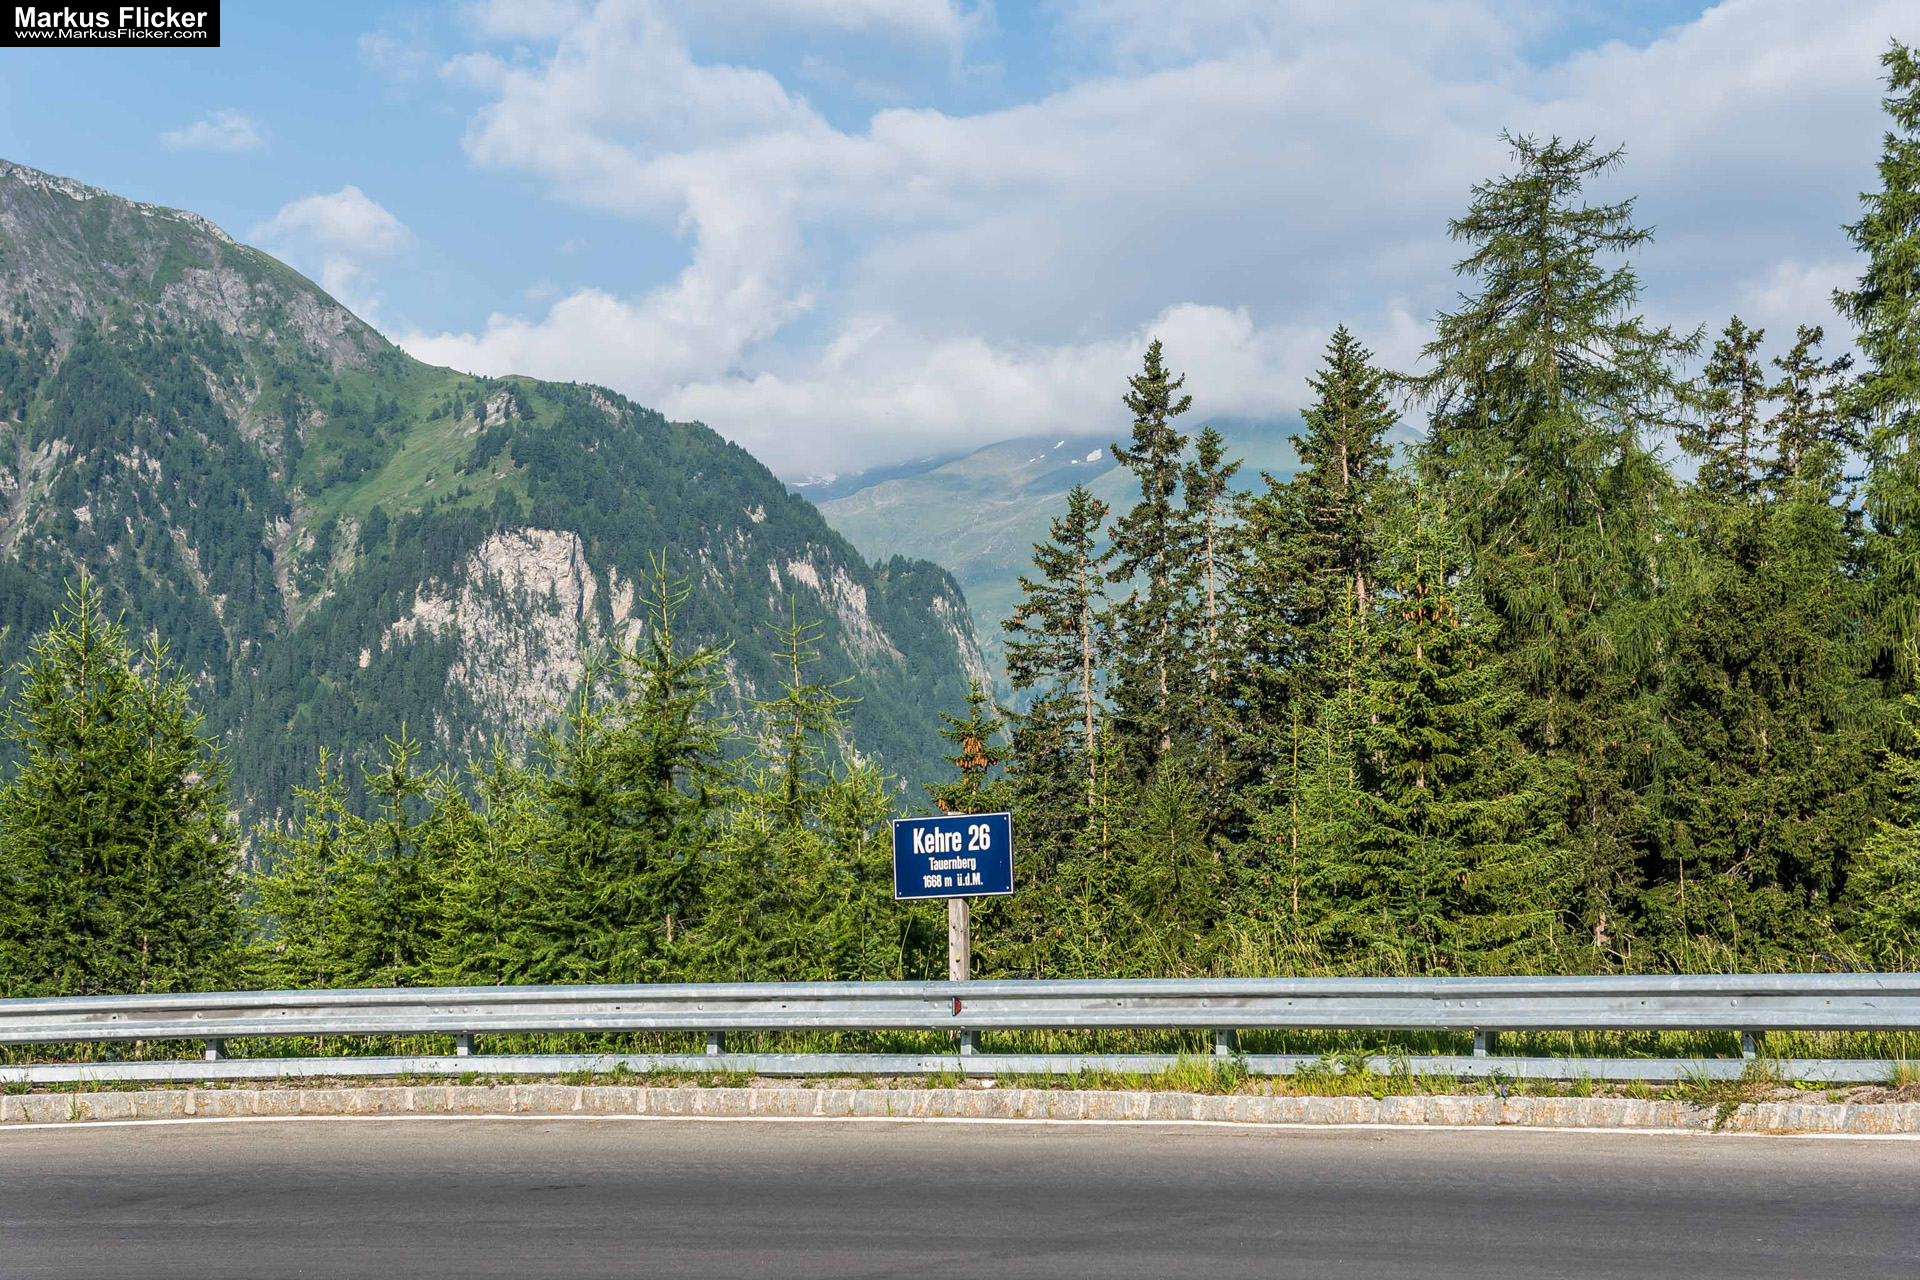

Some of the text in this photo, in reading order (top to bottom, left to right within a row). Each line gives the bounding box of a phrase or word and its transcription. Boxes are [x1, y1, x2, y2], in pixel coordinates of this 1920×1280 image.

[913, 824, 991, 854] Kehre 26
[928, 856, 976, 871] Tauernberg
[922, 872, 984, 888] 1668 m ü.d.M.
